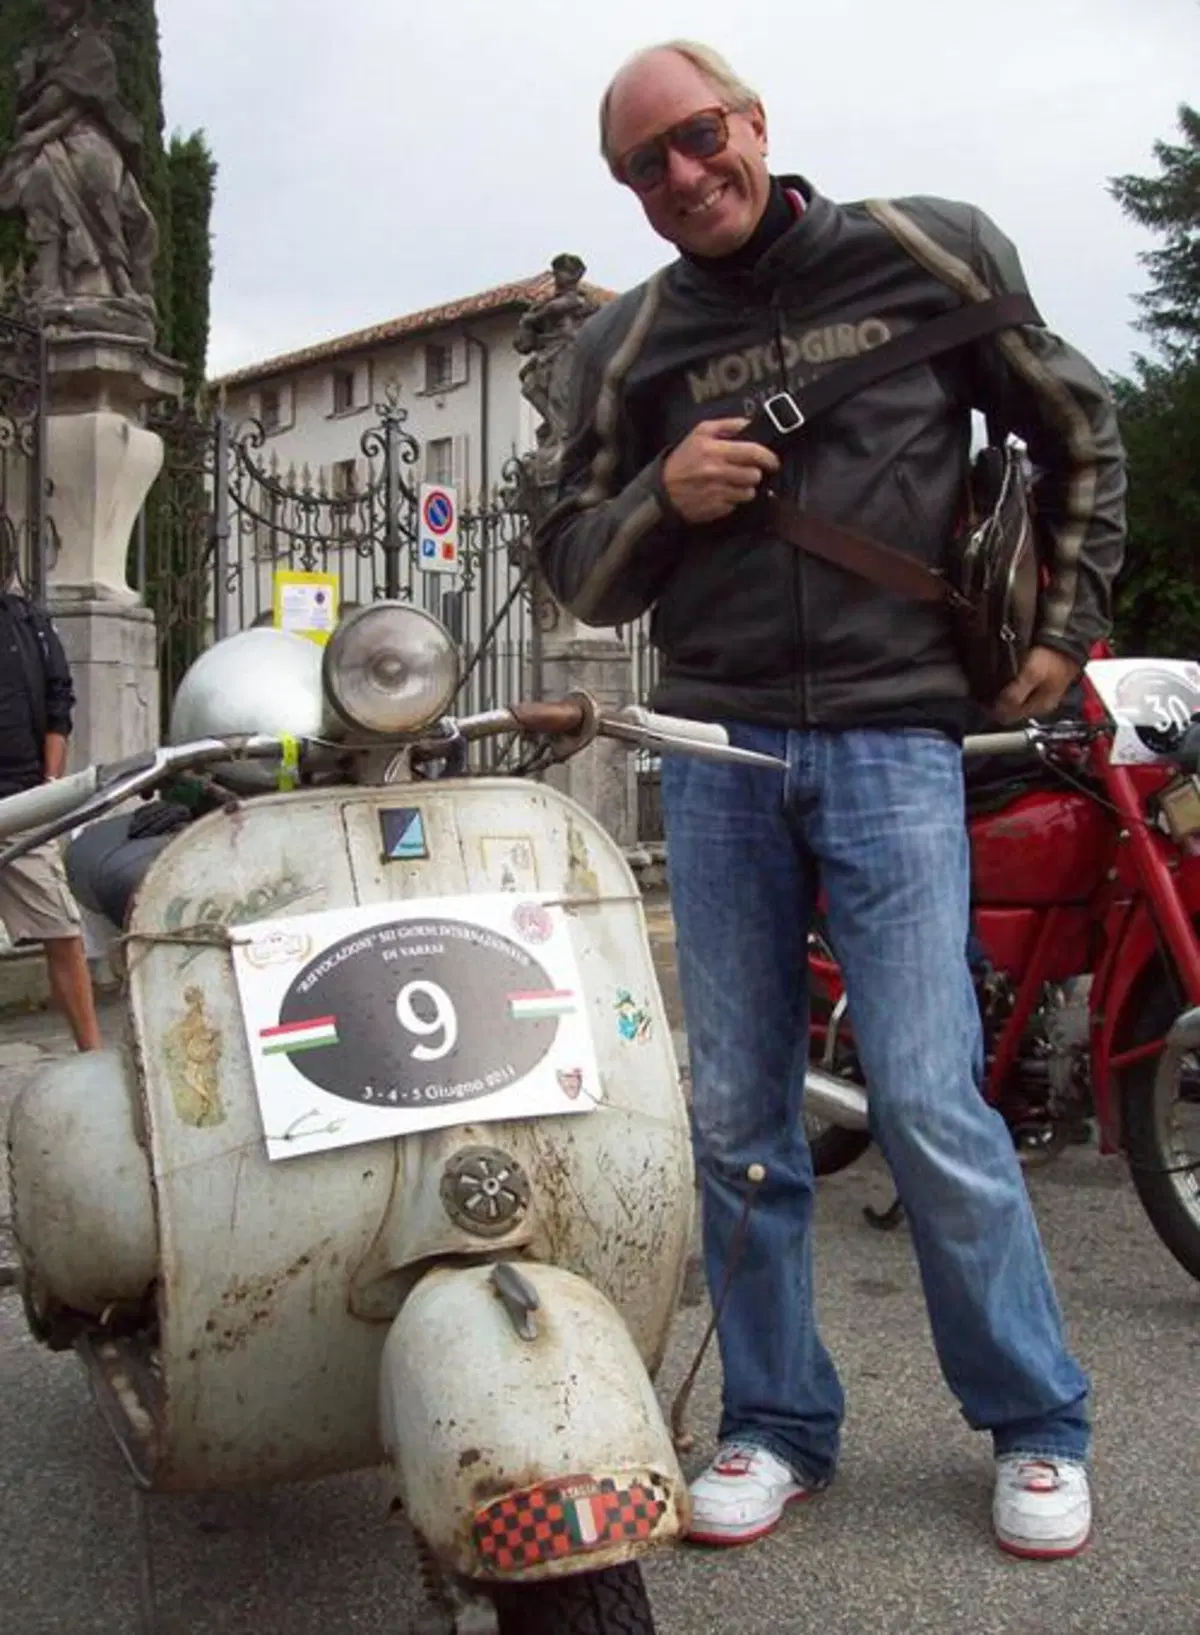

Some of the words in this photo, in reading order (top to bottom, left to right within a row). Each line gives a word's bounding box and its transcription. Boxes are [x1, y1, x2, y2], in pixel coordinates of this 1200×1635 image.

[687, 317, 892, 404] MOTOGIRO
[1144, 694, 1193, 735] 30
[396, 980, 458, 1062] 9
[361, 1085, 374, 1100] 3
[386, 1089, 398, 1102] 4
[424, 1079, 484, 1100] Giugno
